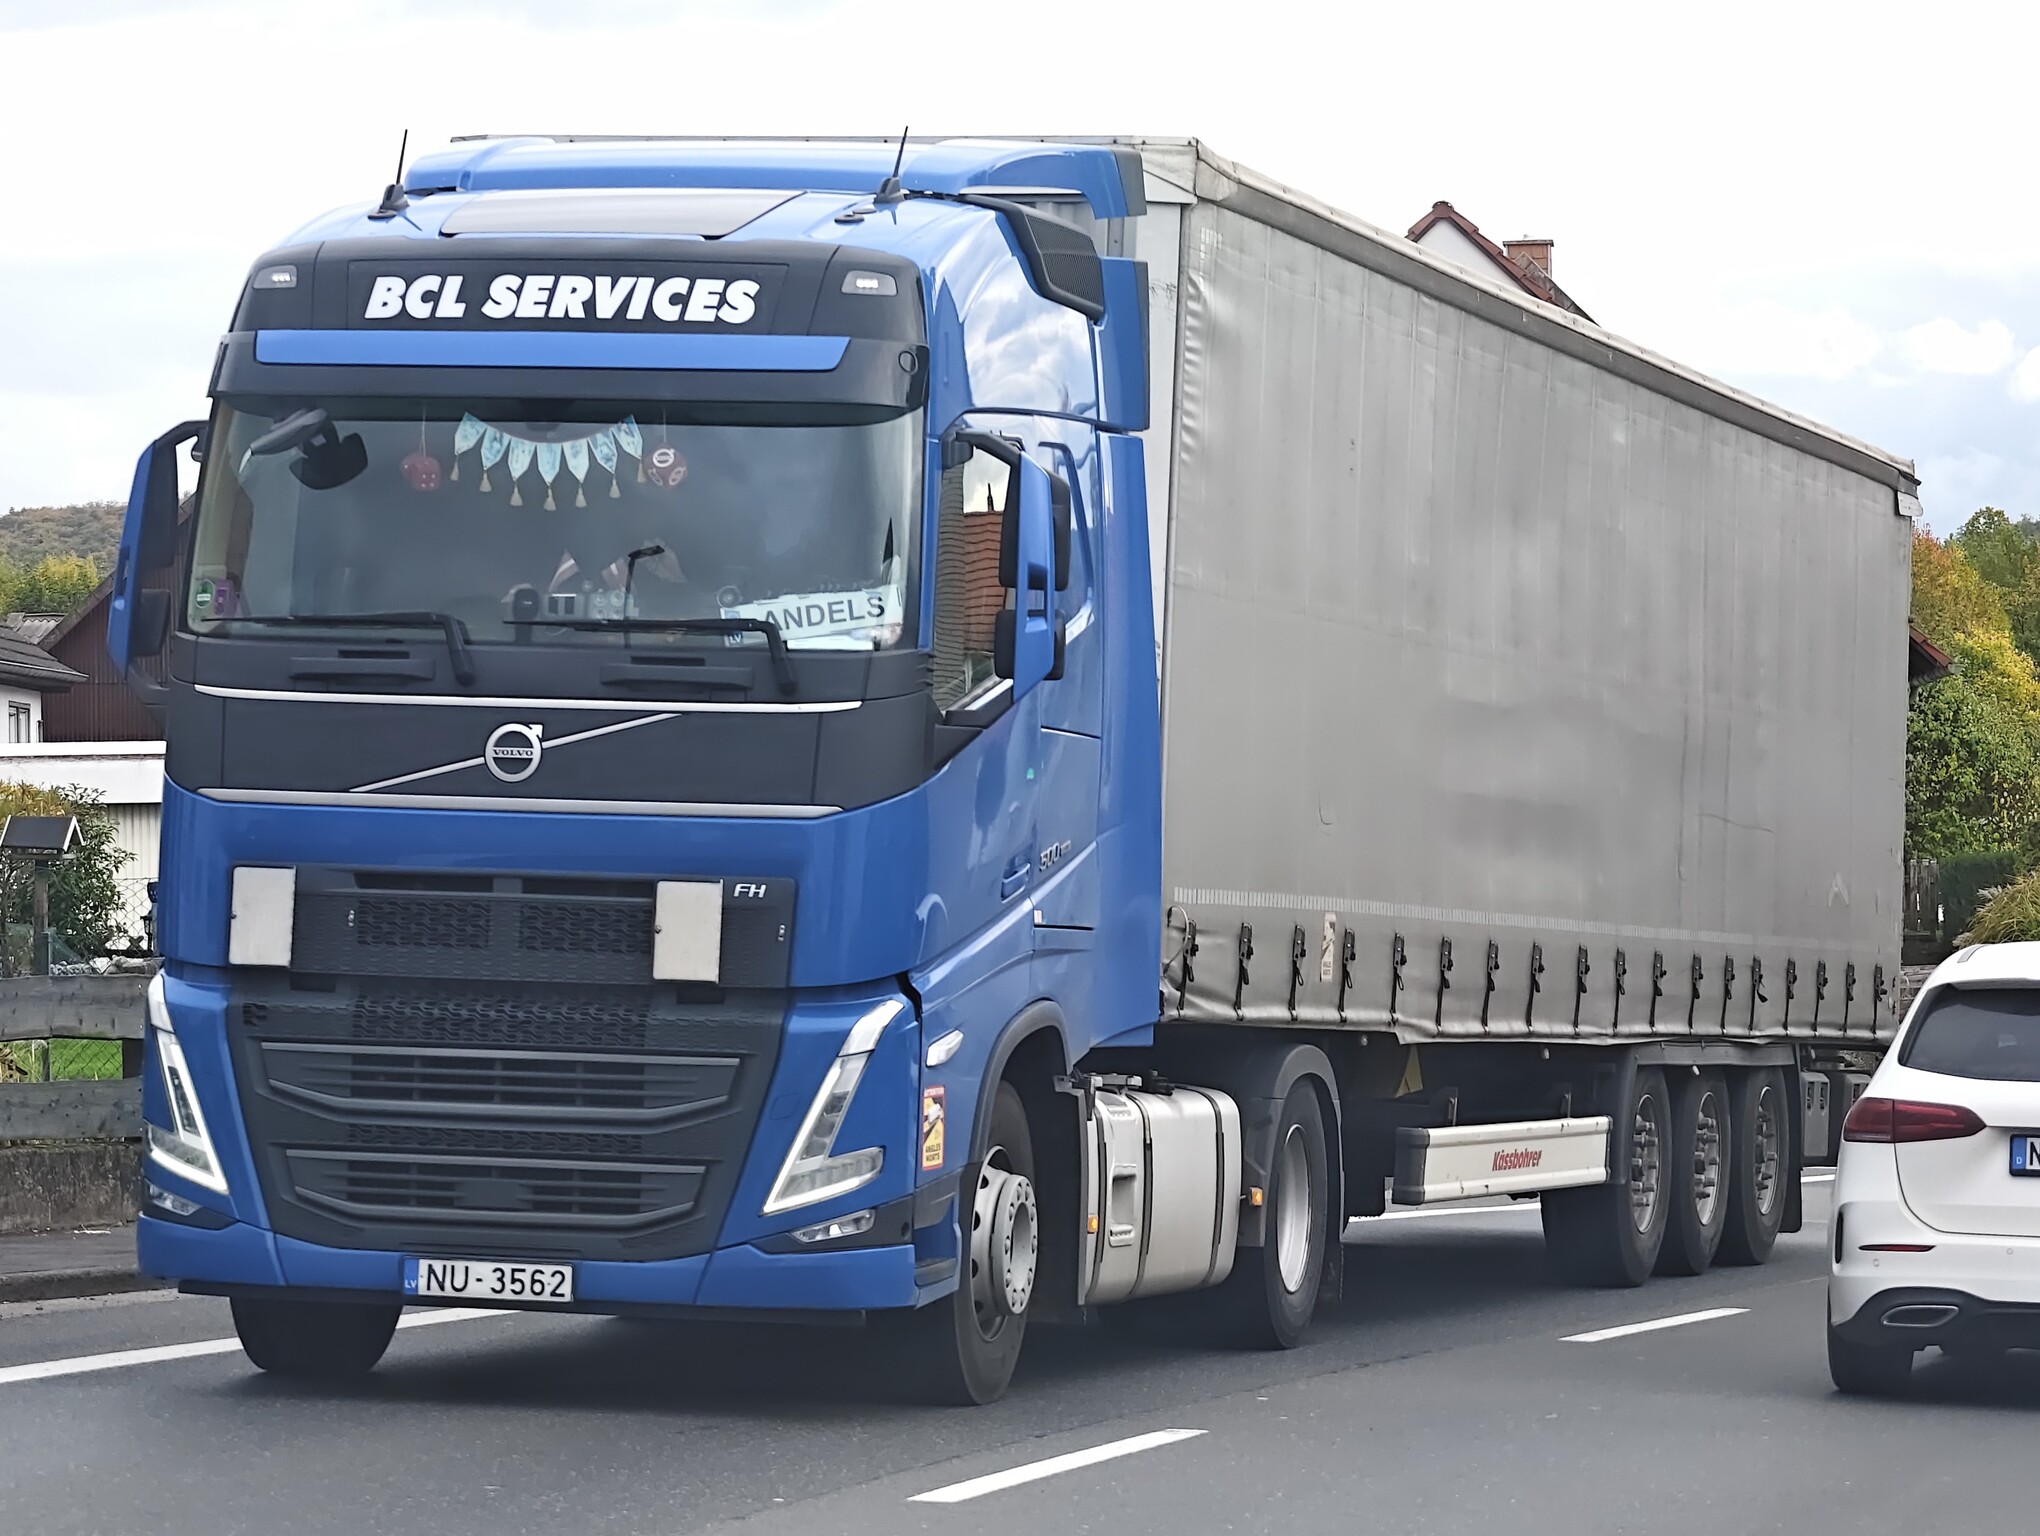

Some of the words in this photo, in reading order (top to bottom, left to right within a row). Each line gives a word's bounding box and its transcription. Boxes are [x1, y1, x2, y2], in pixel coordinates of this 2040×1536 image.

[364, 275, 466, 319] BCL
[480, 274, 761, 324] SERVICES
[492, 749, 534, 757] VOLVO
[733, 883, 767, 898] FH
[2016, 1156, 2023, 1165] D
[404, 1279, 417, 1289] LV
[426, 1263, 566, 1298] NU-3562
